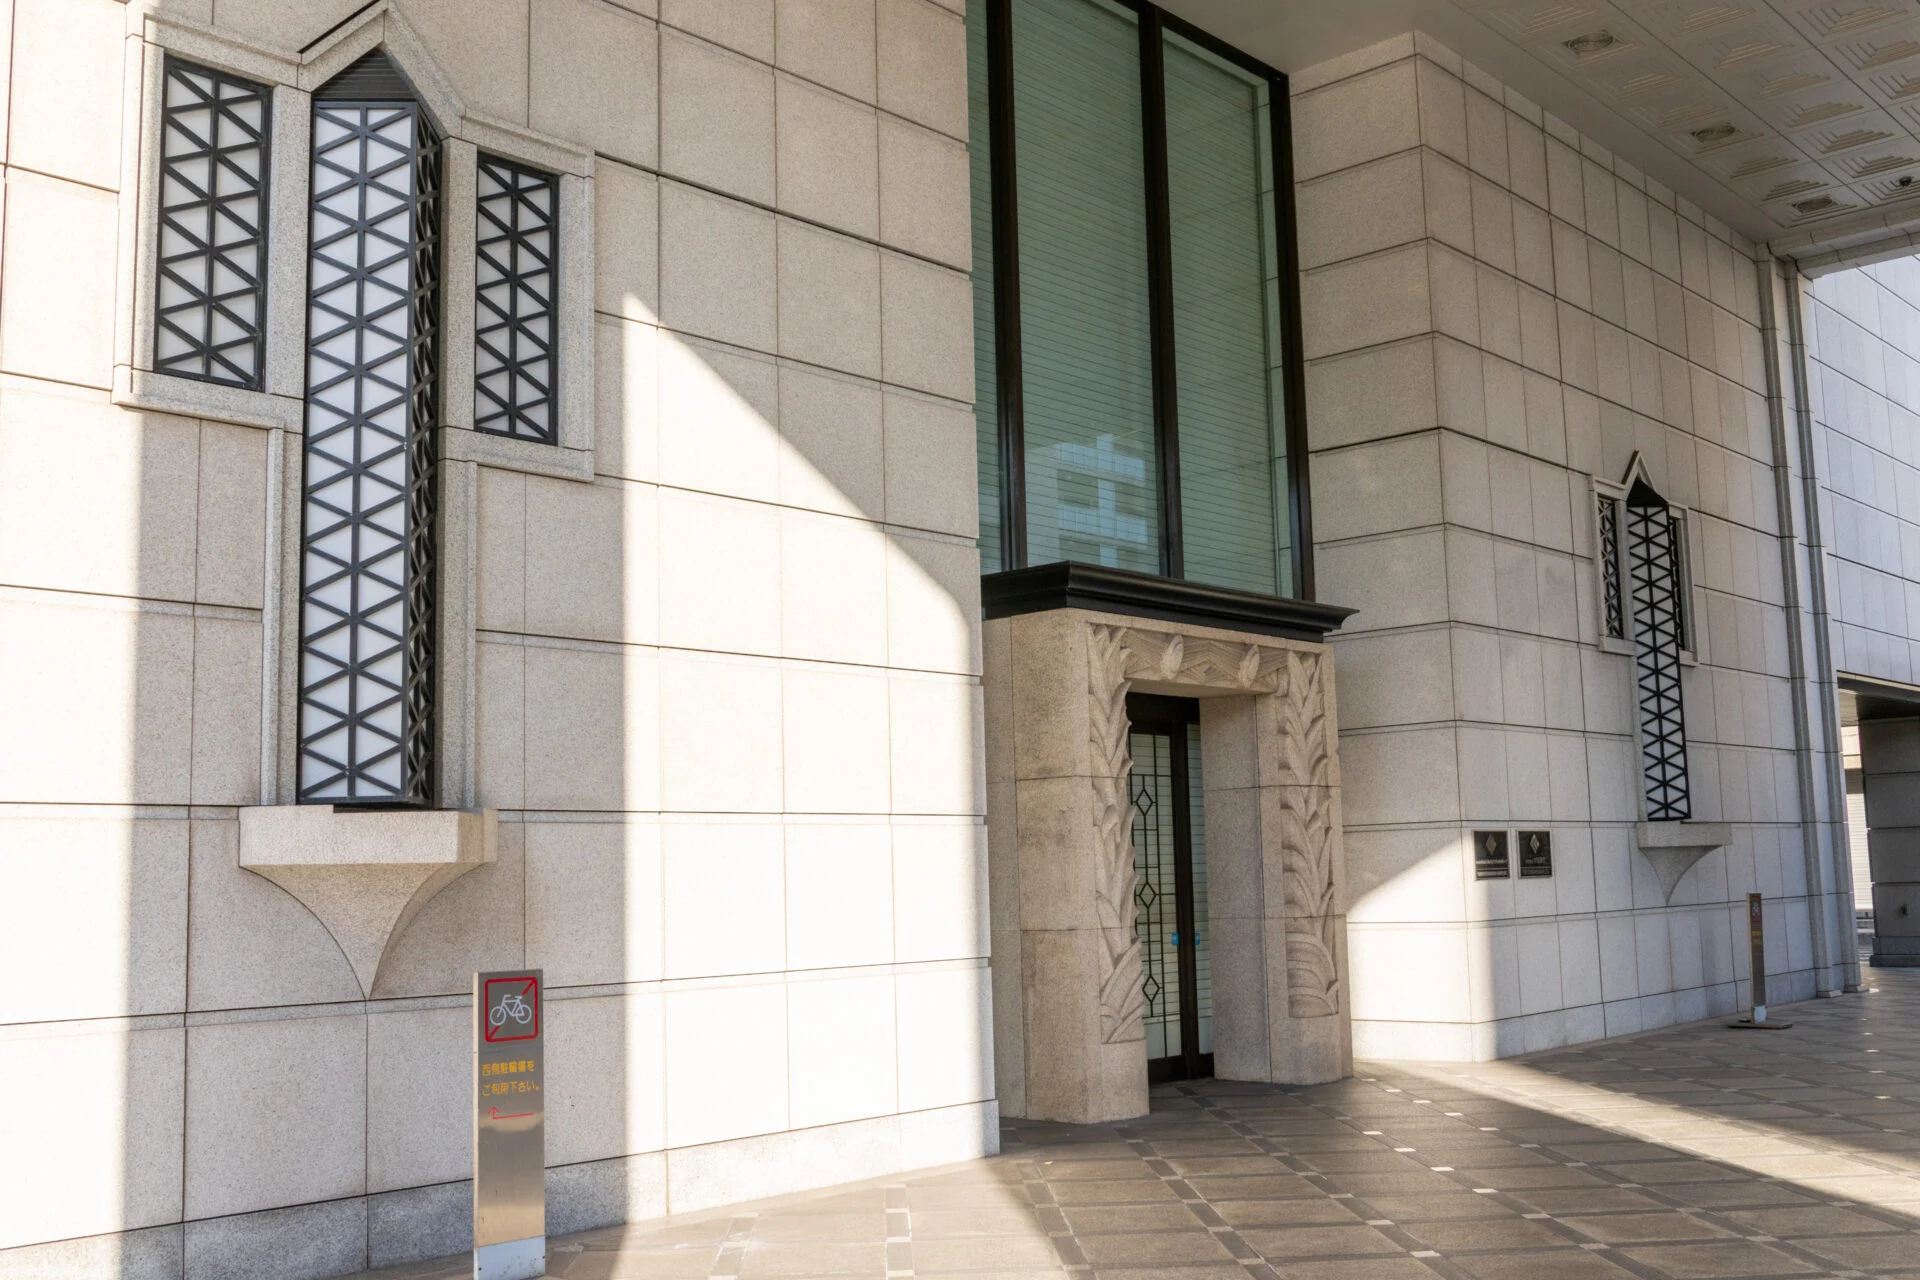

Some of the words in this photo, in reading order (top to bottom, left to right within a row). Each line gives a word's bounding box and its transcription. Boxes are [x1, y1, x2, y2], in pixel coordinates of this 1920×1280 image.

[482, 1080, 540, 1096] ご利用下さい。
